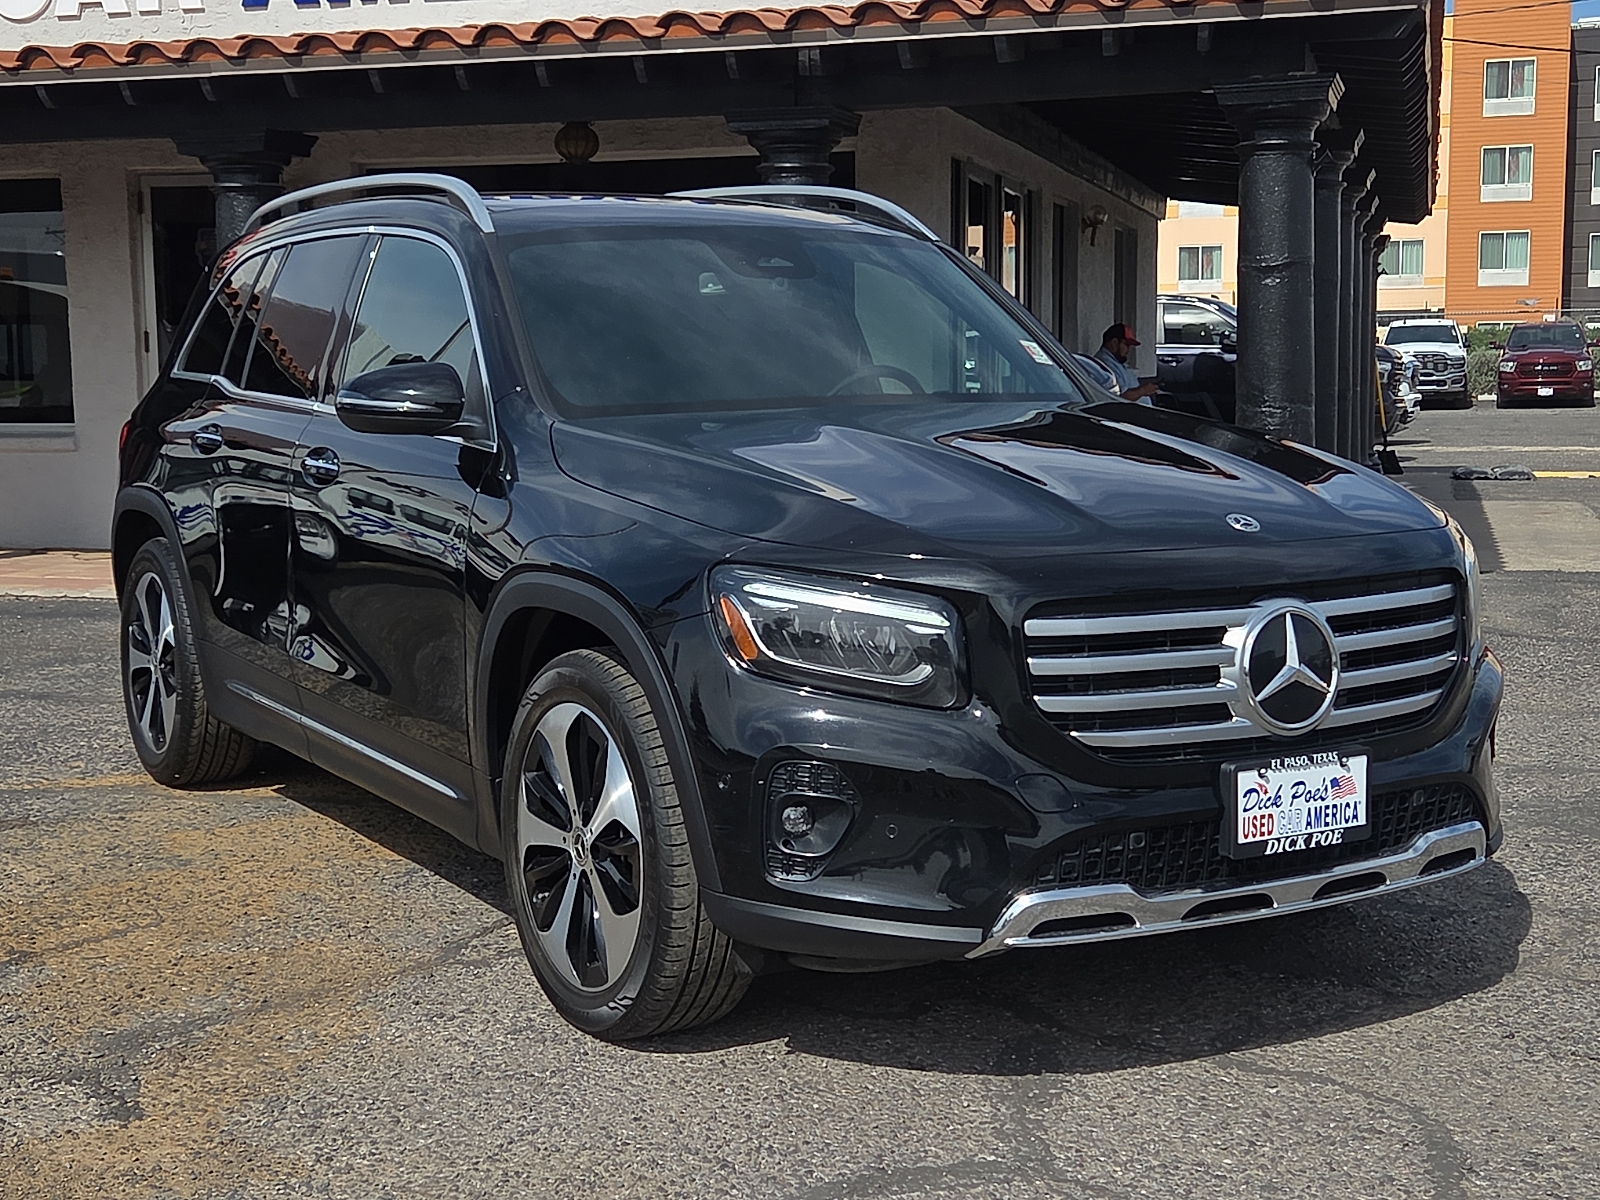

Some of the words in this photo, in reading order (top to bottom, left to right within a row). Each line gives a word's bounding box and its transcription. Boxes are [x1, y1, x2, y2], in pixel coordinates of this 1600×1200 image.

[1271, 758, 1281, 770] EL
[1312, 751, 1339, 765] TEXAS
[1242, 783, 1284, 813] Dick
[1290, 776, 1329, 807] Poe's
[1242, 813, 1274, 840] USED
[1277, 808, 1302, 835] CAR
[1304, 800, 1359, 830] AMERICA
[1264, 835, 1307, 855] DICK
[1309, 829, 1344, 849] POE
